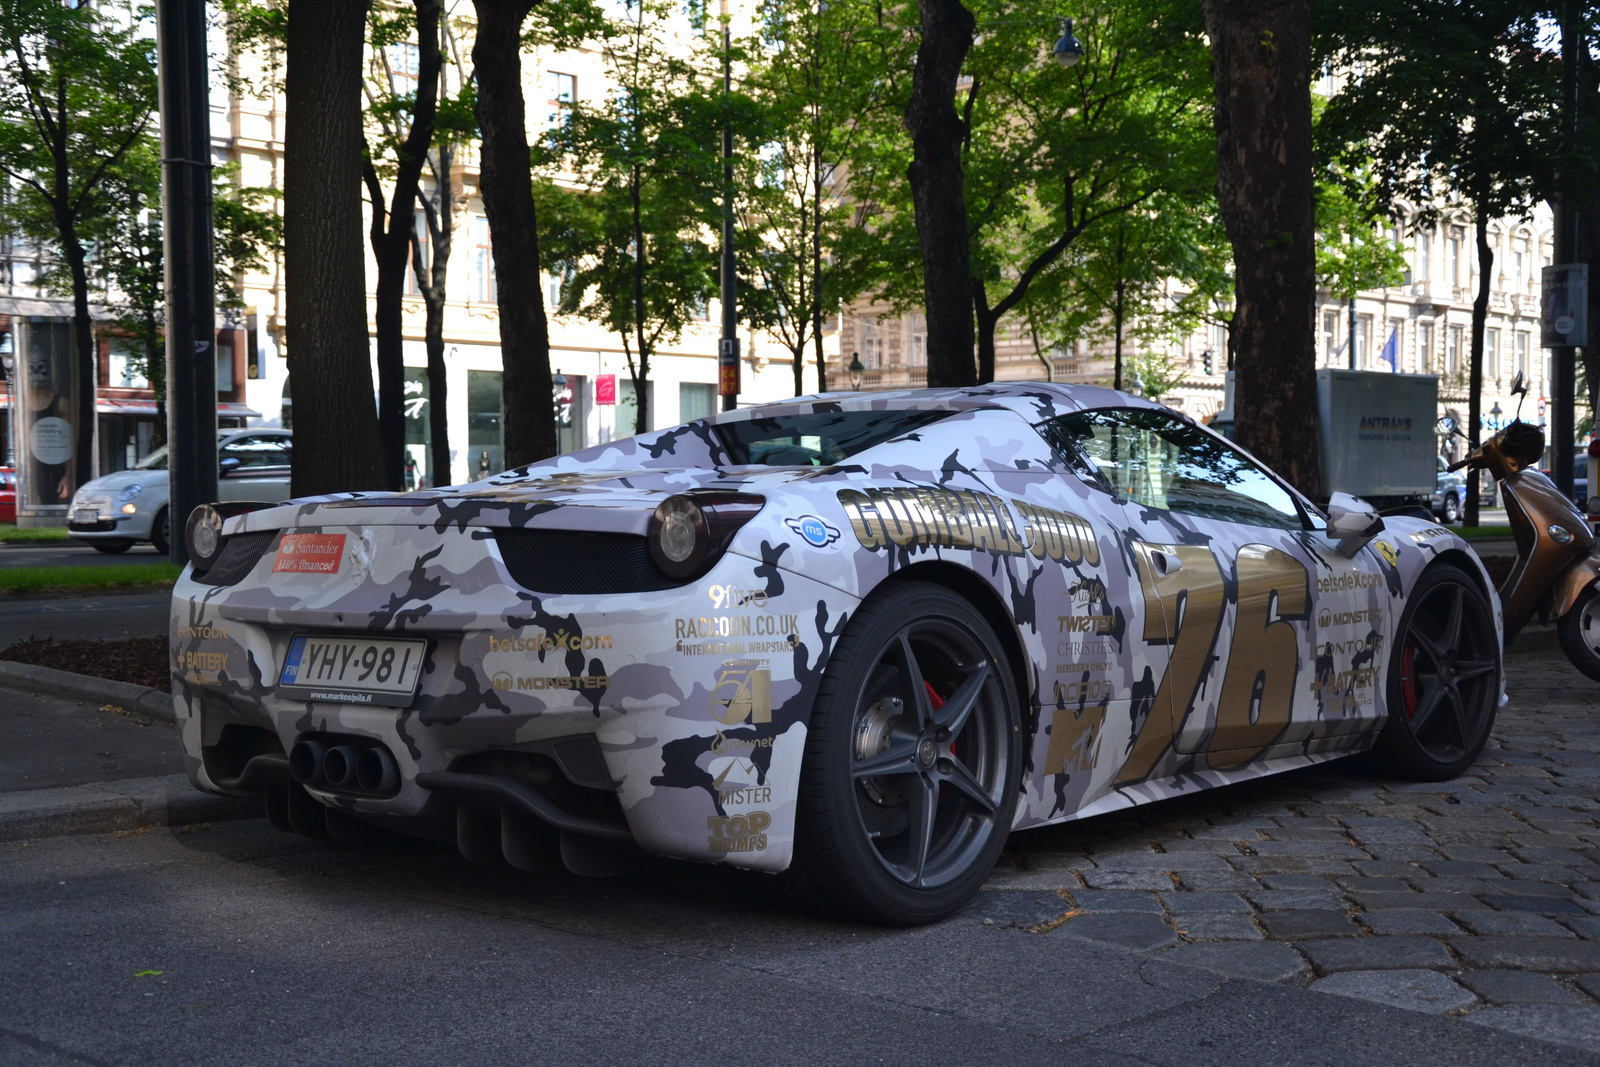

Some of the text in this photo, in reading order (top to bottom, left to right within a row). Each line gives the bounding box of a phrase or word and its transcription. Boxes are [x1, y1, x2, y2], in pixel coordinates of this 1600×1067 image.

[1359, 416, 1412, 430] ANTRANS
[805, 525, 823, 536] ms
[836, 487, 1101, 568] GUMBALL 3000
[296, 540, 339, 554] Santander
[277, 559, 334, 571] 110% financed
[708, 584, 769, 609] 9five
[1069, 580, 1105, 603] Kiehl's
[675, 614, 800, 639] RACCOON.CO.UK
[1333, 608, 1384, 627] MONSTER
[177, 626, 229, 639] CONTOUR
[1057, 640, 1114, 657] CHRISTIE'S
[1315, 636, 1384, 658] CONTOUR
[284, 665, 298, 676] FIN
[306, 643, 412, 685] YHY-981
[723, 658, 771, 667] COMMUNITY
[1056, 663, 1090, 675] MEMBERS
[518, 676, 611, 690] MONSTER
[1053, 681, 1101, 702] INCIPIO
[310, 692, 373, 703] www.markosipila.fi
[718, 787, 772, 806] MISTER
[707, 810, 772, 838] TOP
[707, 834, 768, 853] TRUMPS
